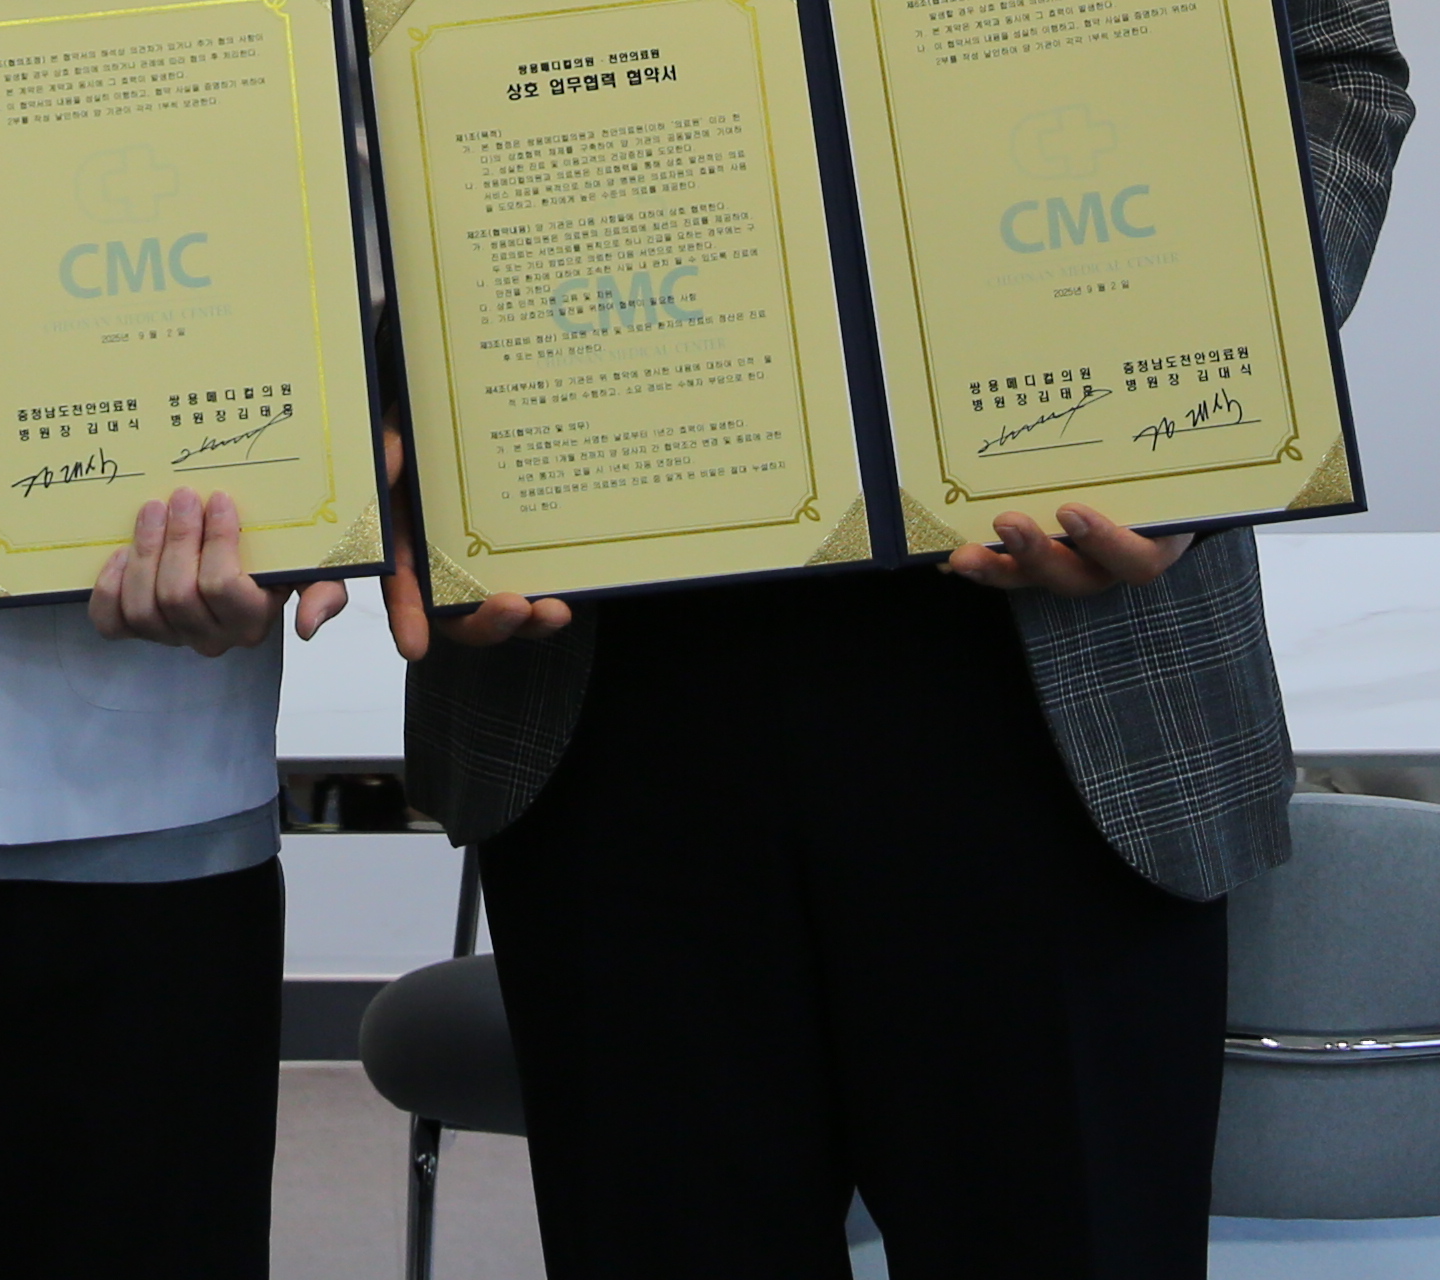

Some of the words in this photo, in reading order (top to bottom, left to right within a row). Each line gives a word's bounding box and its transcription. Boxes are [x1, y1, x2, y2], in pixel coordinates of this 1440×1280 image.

[504, 77, 541, 103] 상호
[548, 71, 617, 97] 업무협력
[625, 61, 678, 88] 협약서
[999, 184, 1157, 254] CMC
[58, 232, 212, 299] CMC
[551, 265, 705, 334] CMC
[1122, 345, 1250, 377] 충청남도천안의료원
[968, 366, 1093, 396] 쌍용메디컬의원
[1124, 372, 1181, 393] 병원장
[1195, 361, 1253, 384] 김대식
[16, 397, 138, 423] 충청남도천안의료원
[167, 382, 293, 409] 쌍용메디컬의원
[972, 392, 1028, 412] 병원장
[18, 423, 72, 443] 병원장
[86, 417, 140, 436] 김대식
[171, 409, 227, 427] 병원장
